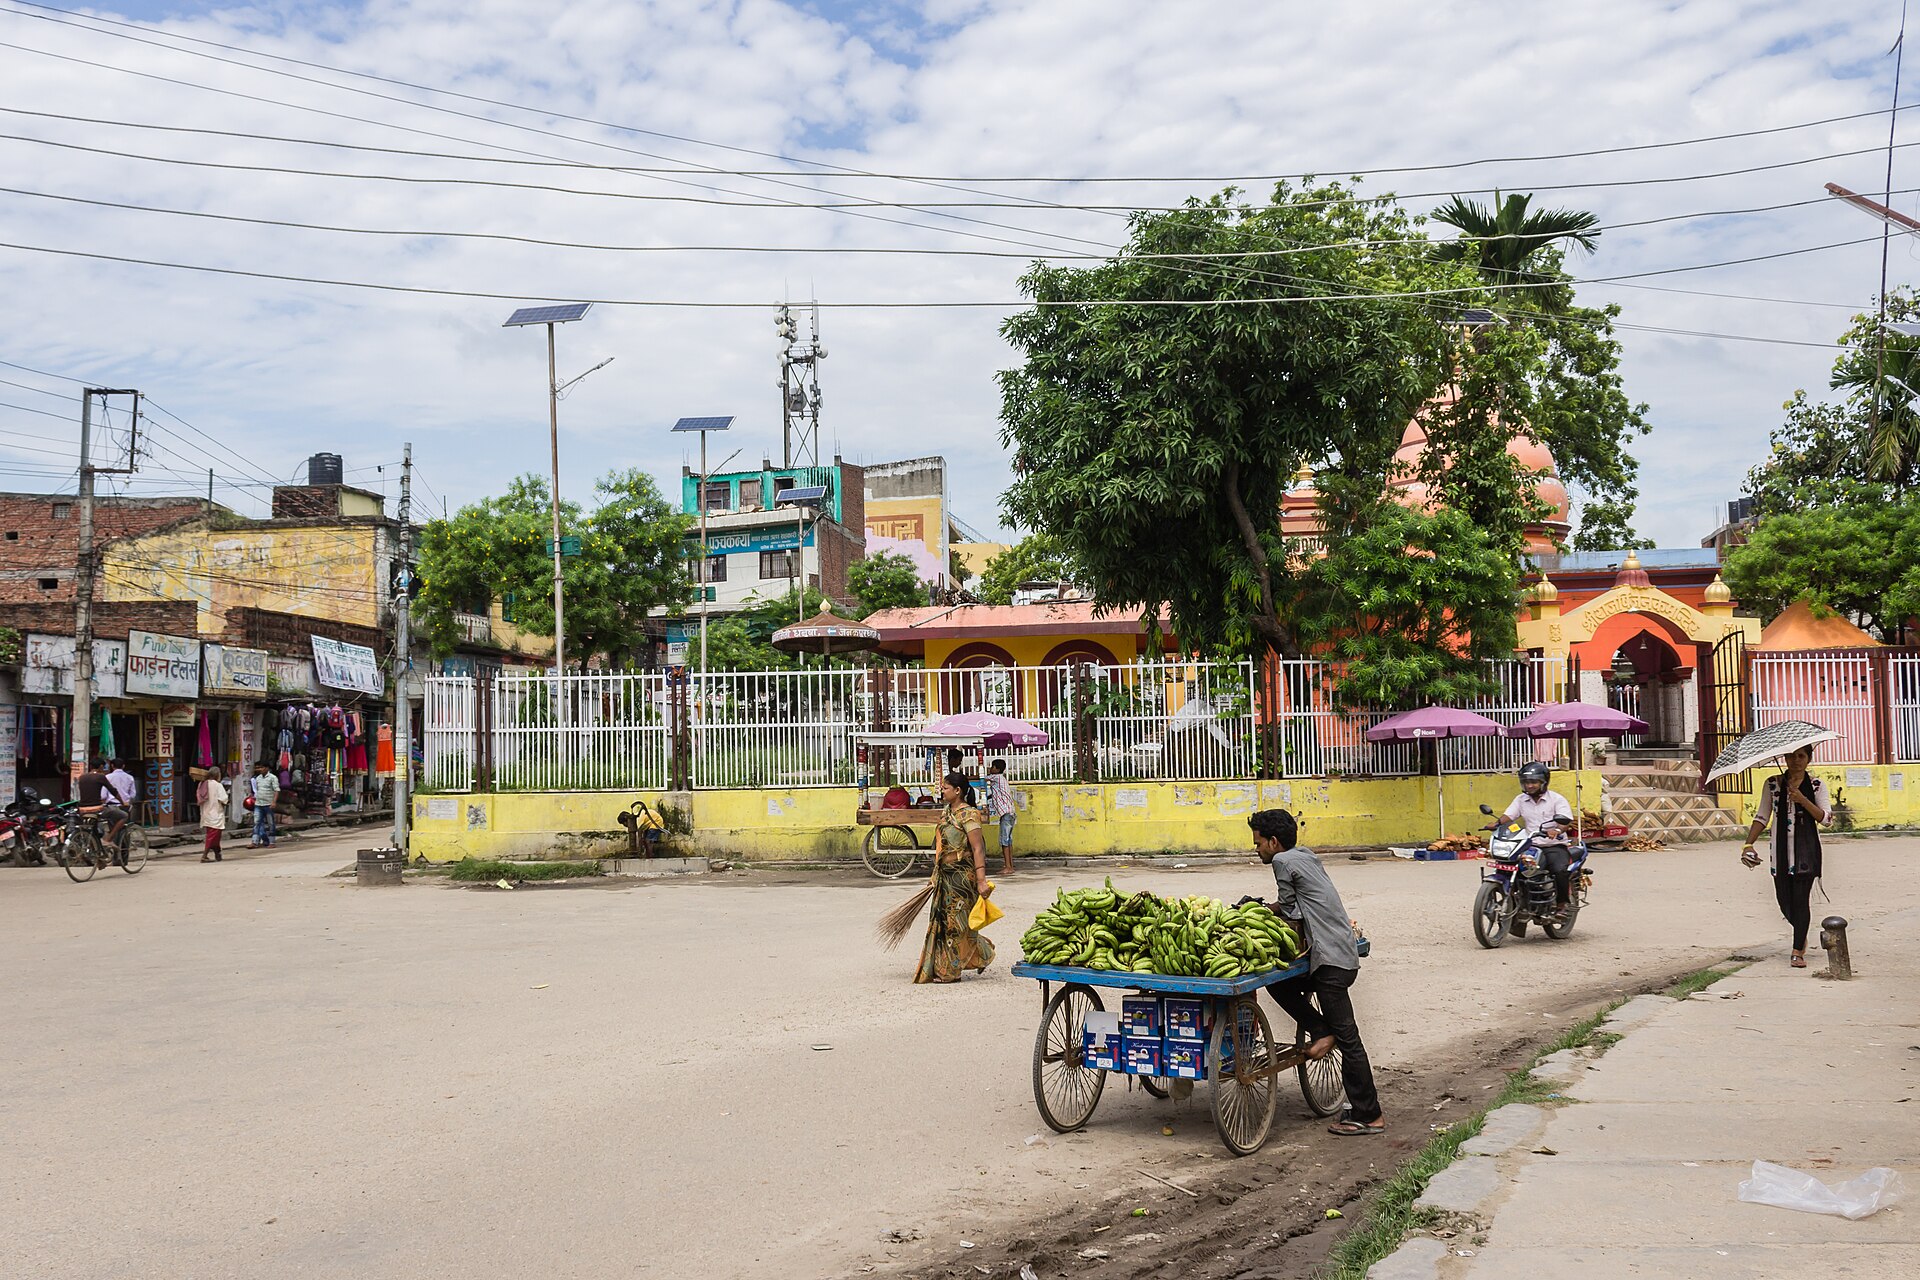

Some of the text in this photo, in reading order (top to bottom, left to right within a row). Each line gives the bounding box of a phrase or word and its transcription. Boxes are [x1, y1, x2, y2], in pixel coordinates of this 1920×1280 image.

[142, 636, 166, 653] Fine
[129, 655, 169, 679] फाईन
[170, 657, 198, 680] टेलर्स
